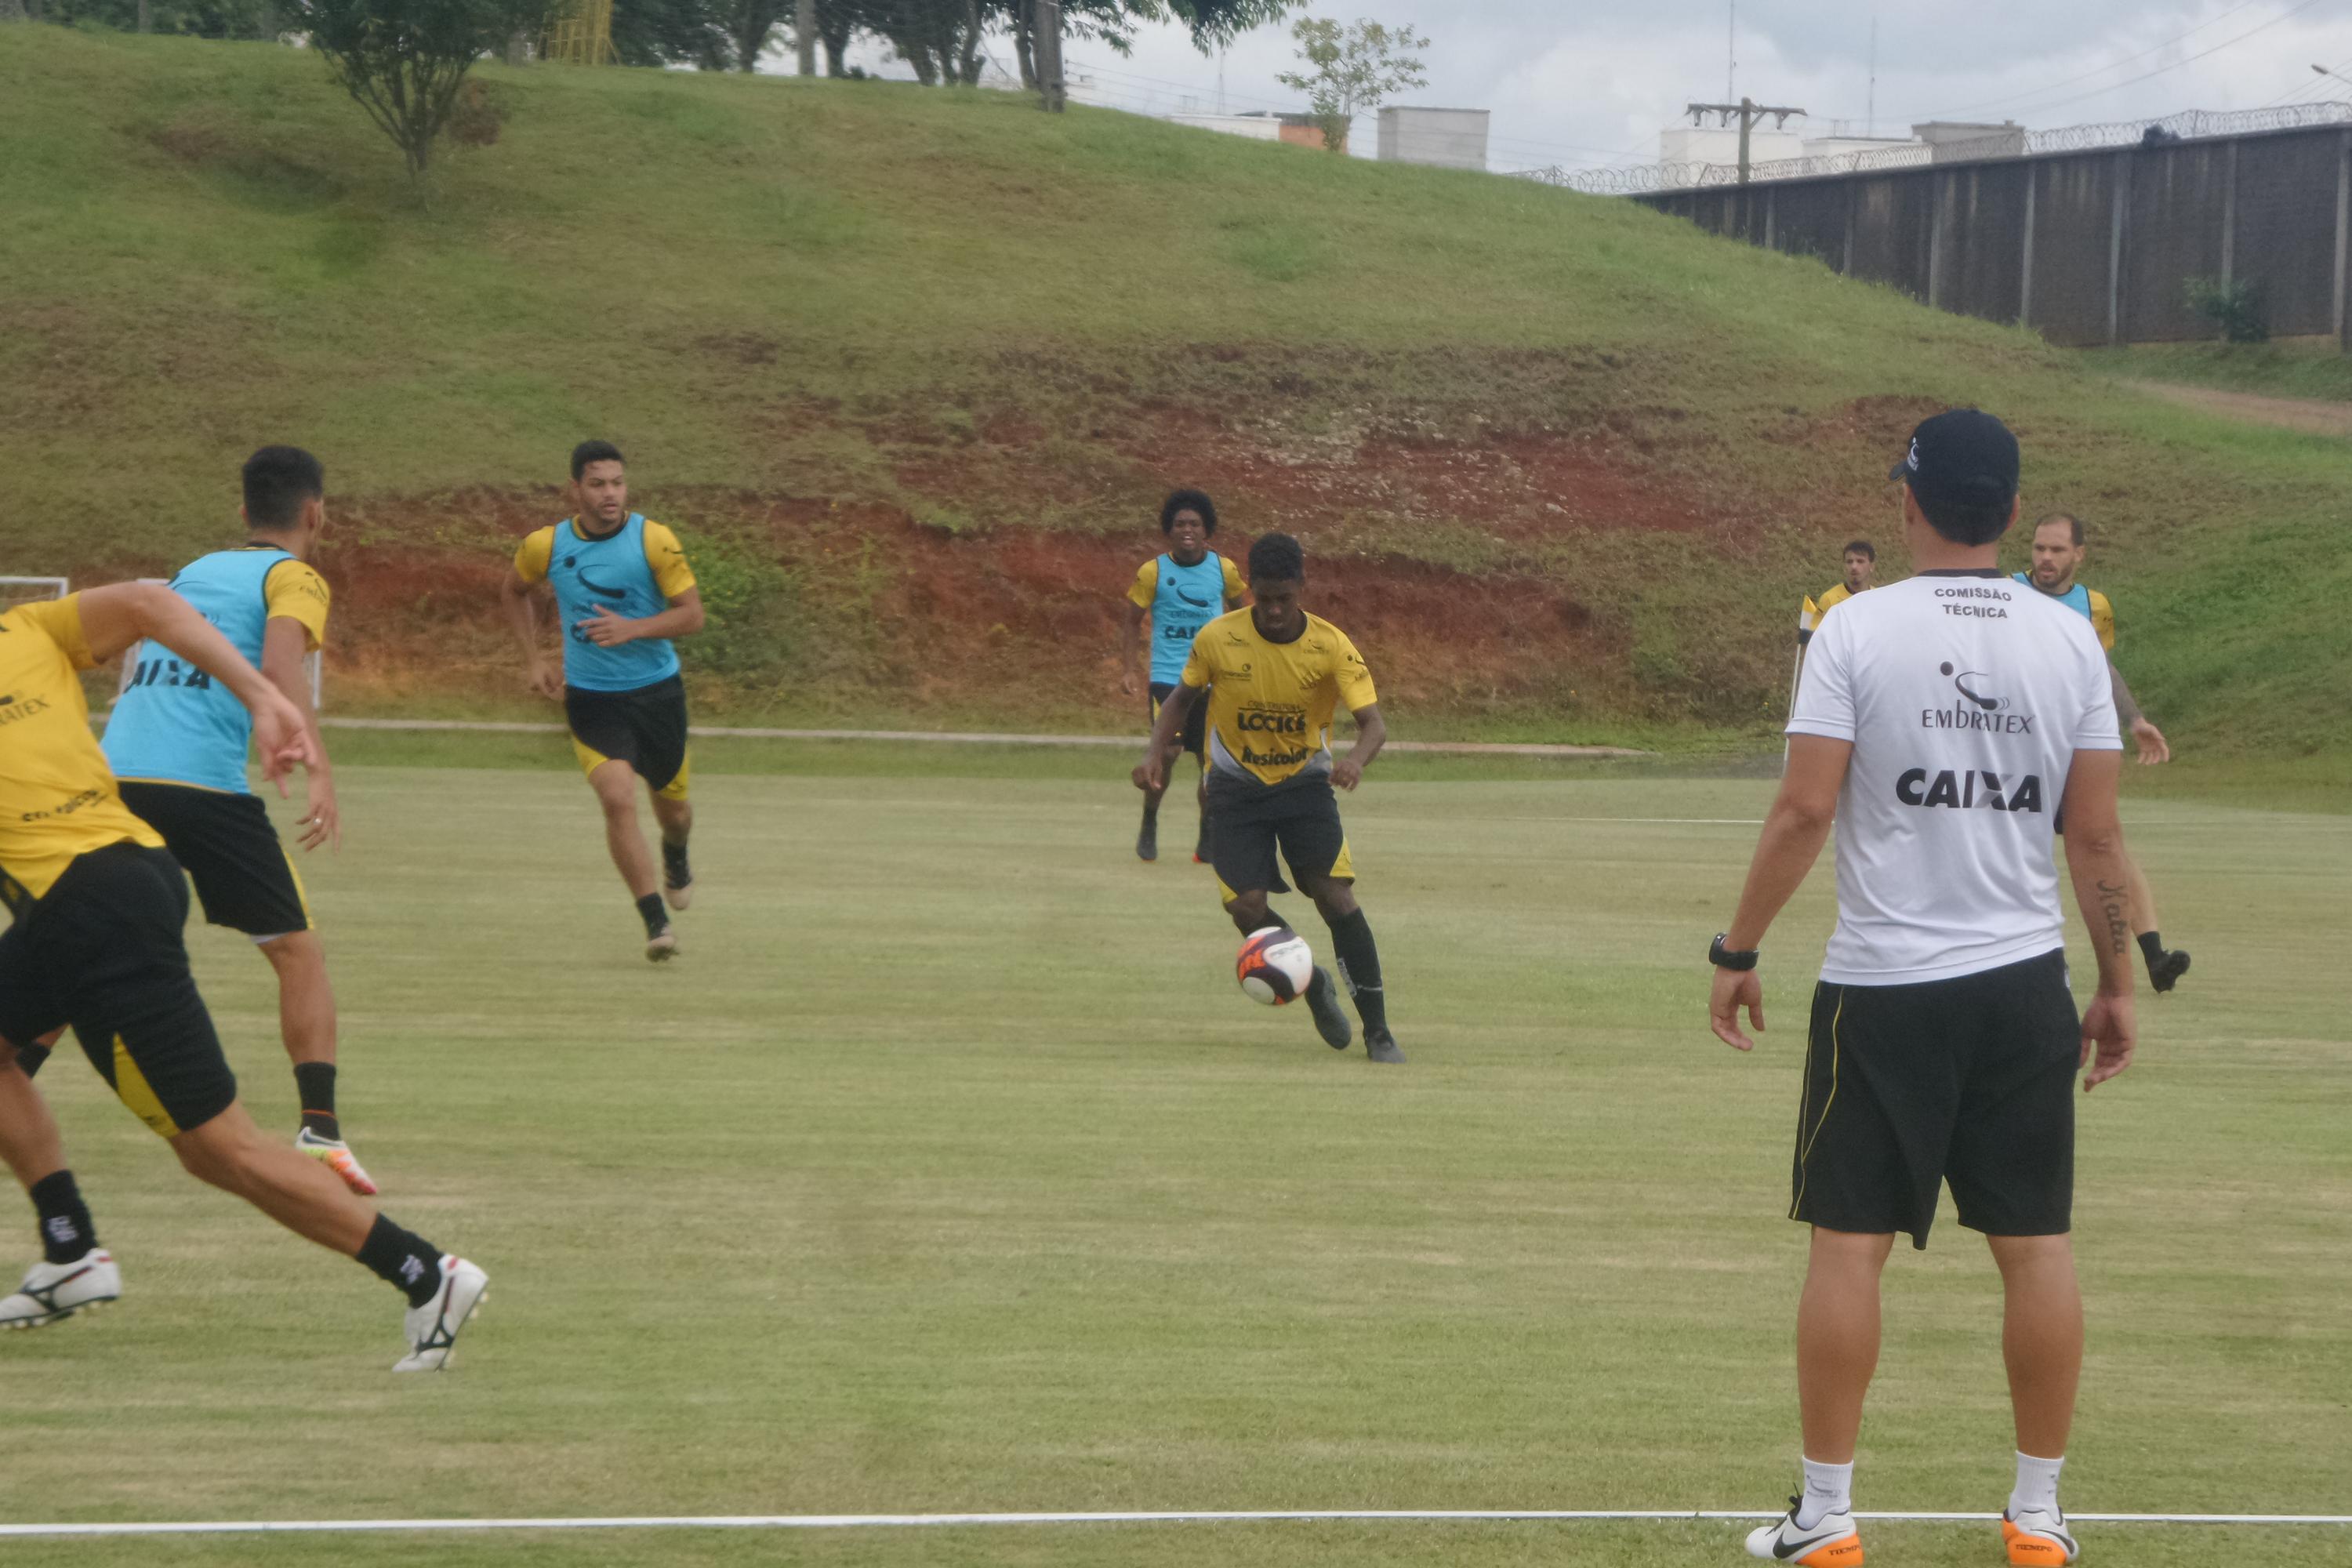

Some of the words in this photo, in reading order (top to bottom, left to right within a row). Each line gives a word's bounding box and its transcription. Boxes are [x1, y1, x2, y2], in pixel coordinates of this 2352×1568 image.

[1934, 588, 2012, 601] COMISSÃO
[1942, 603, 2008, 619] TÉCNICA
[1896, 768, 2042, 812] CAIXA
